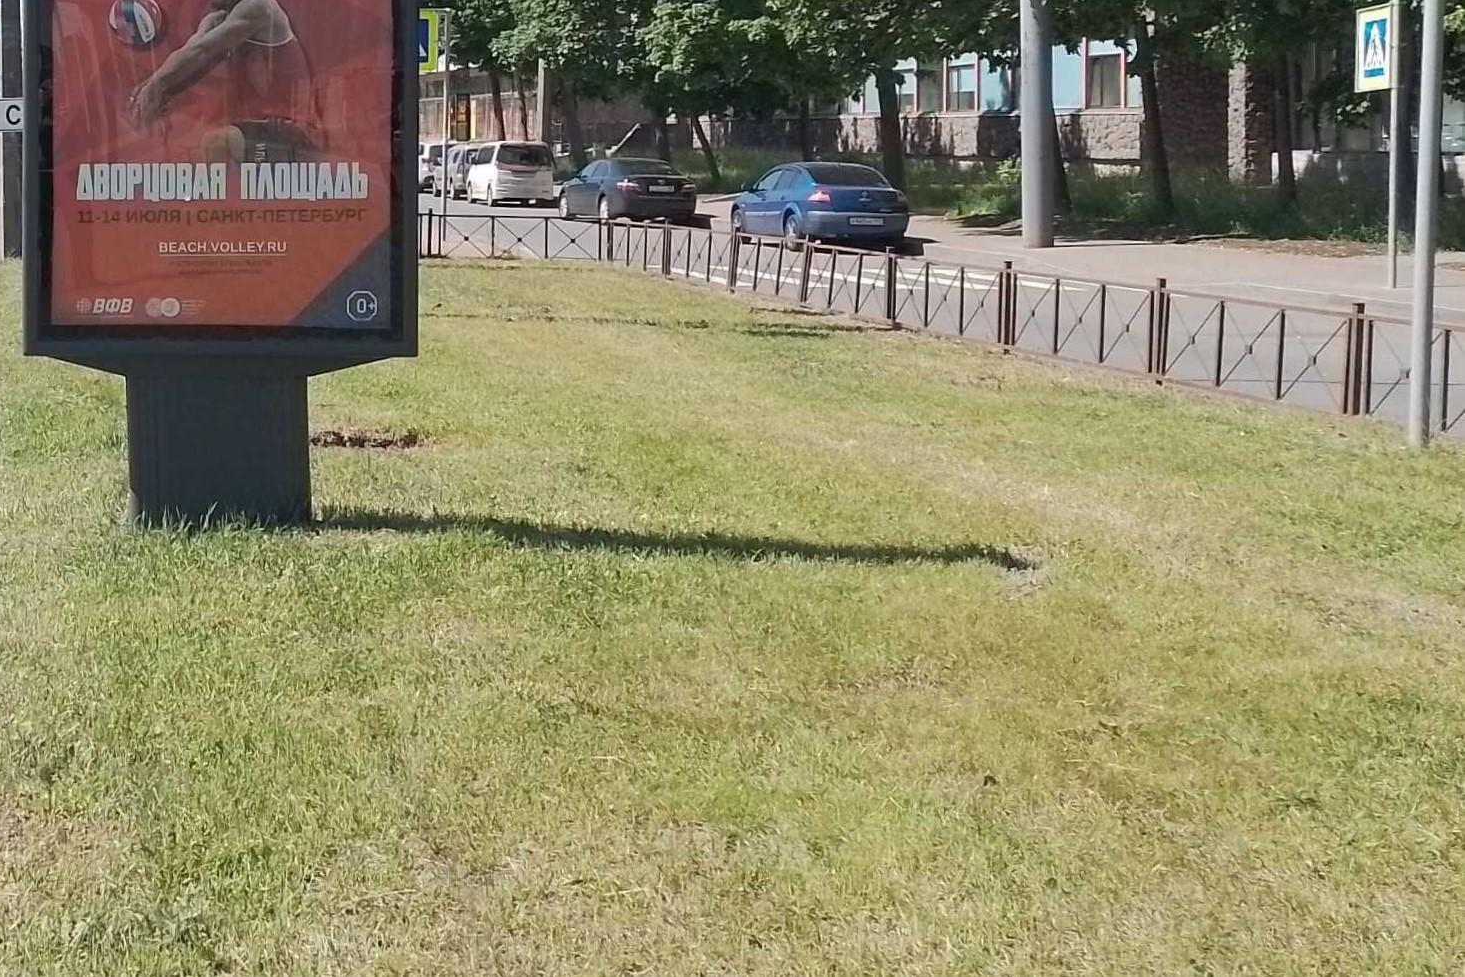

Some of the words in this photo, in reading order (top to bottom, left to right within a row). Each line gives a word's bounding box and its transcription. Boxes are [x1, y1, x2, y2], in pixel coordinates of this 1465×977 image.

[76, 163, 227, 201] ДВОРЦОВАЯ
[240, 162, 368, 201] ПЛОЩАДЬ
[78, 210, 120, 223] 11-14
[126, 209, 181, 223] ИЮЛЯ
[196, 207, 367, 223] САНКТ-ПЕТЕРБУРГ
[158, 240, 288, 254] BEACH.VOLLEY.RU
[93, 298, 134, 314] ВФВ
